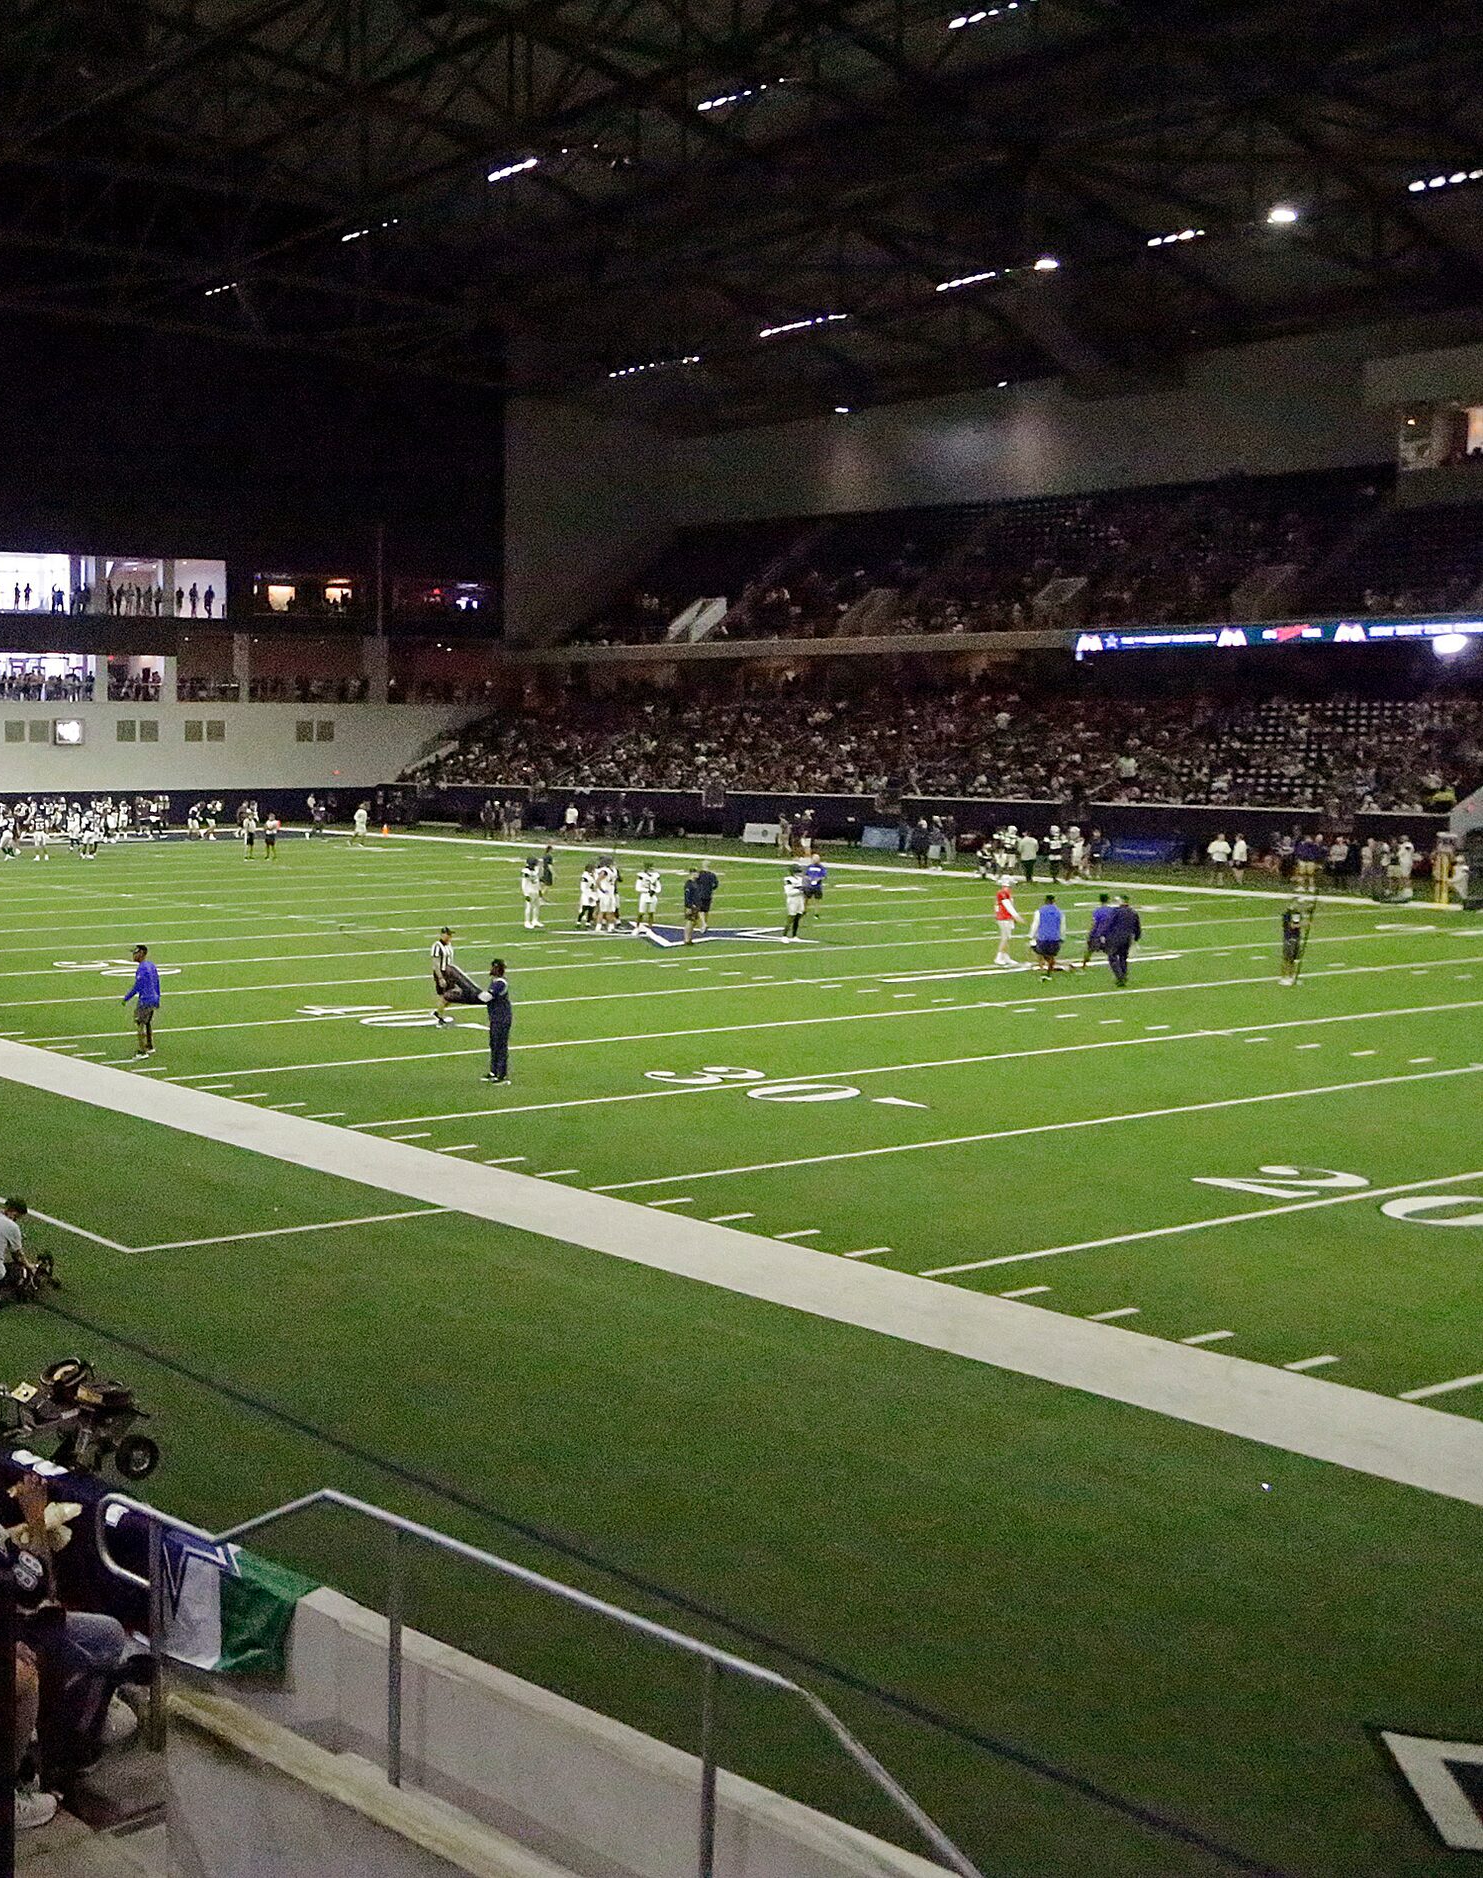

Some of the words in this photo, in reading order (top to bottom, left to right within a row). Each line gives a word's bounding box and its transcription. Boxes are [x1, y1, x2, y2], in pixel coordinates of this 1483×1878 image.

[295, 1005, 454, 1028] 40
[644, 1066, 862, 1103] 30
[1191, 1165, 1483, 1226] 20
[13, 1551, 44, 1591] 88
